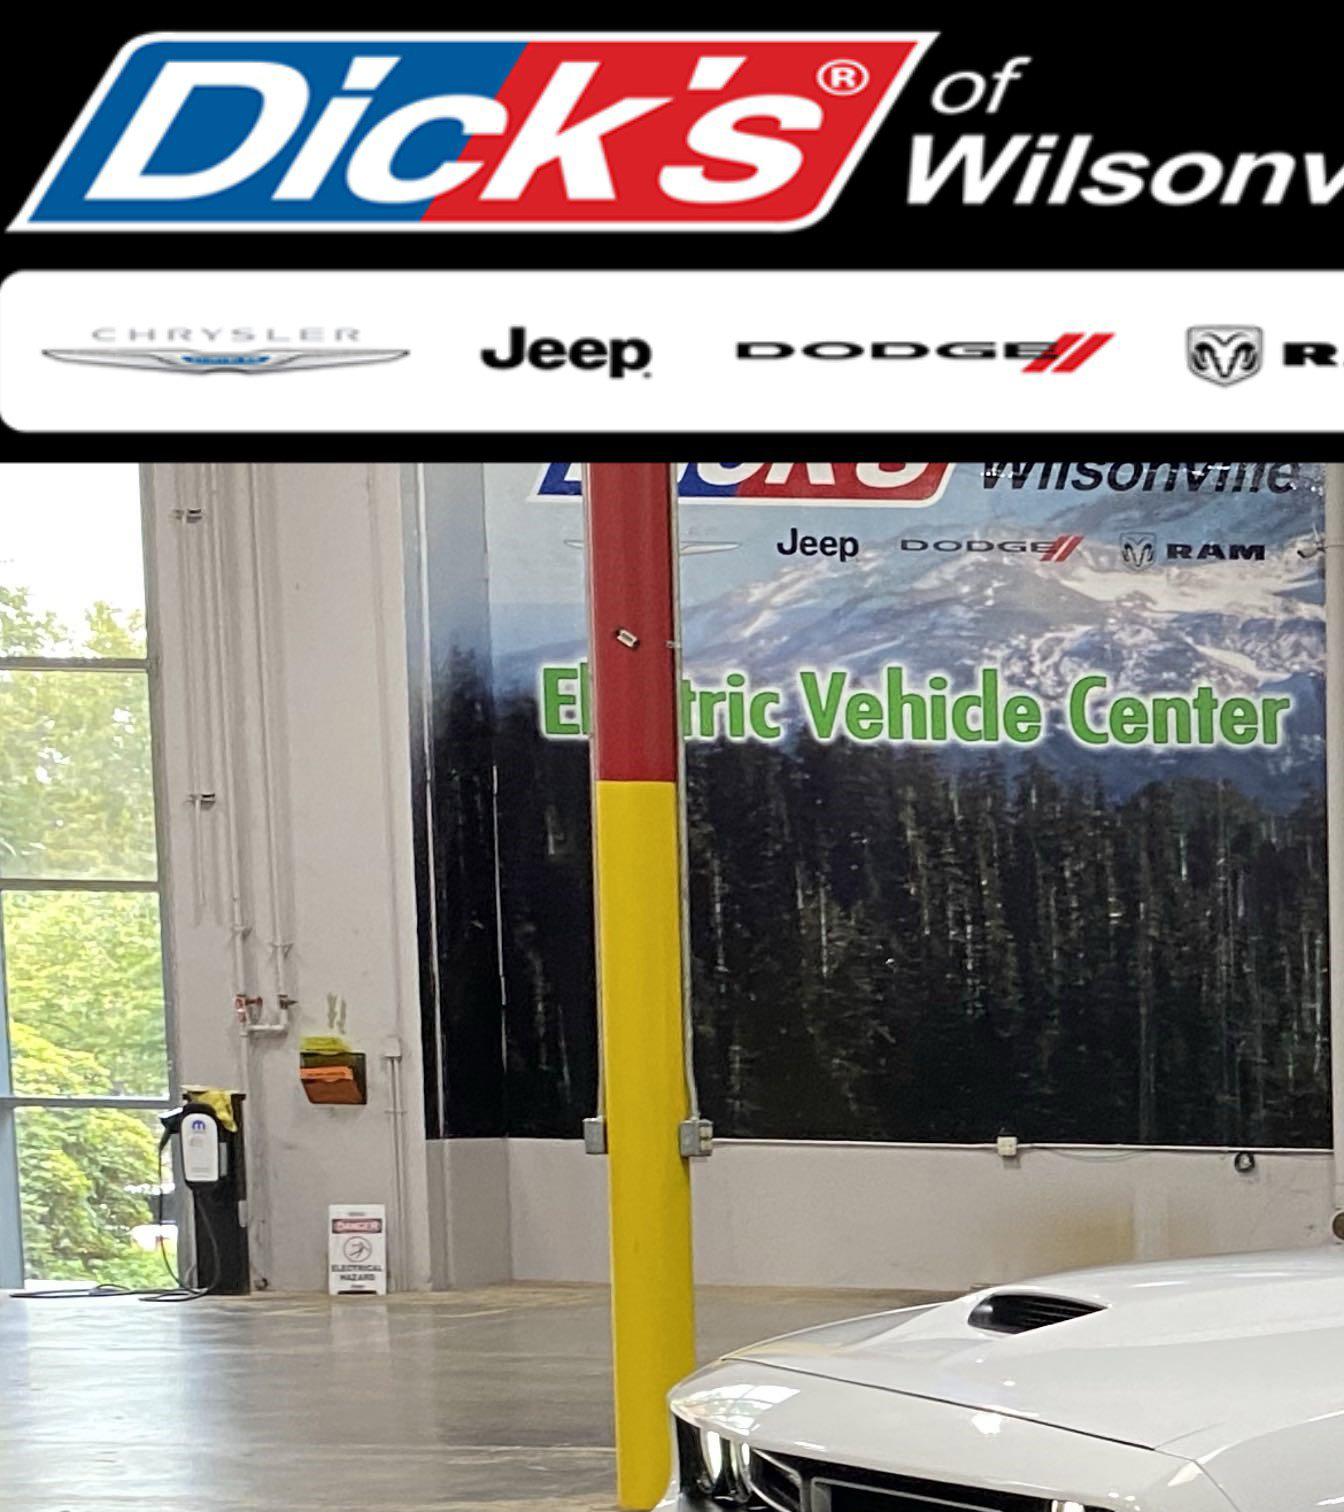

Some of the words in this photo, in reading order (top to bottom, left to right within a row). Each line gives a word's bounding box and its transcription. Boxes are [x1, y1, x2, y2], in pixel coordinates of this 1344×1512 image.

[777, 527, 860, 562] Jeep
[901, 538, 1057, 554] DODGE
[1166, 543, 1266, 562] RAM
[543, 662, 781, 738] Eltric
[800, 666, 1043, 743] Vehicle
[1069, 675, 1290, 745] Center
